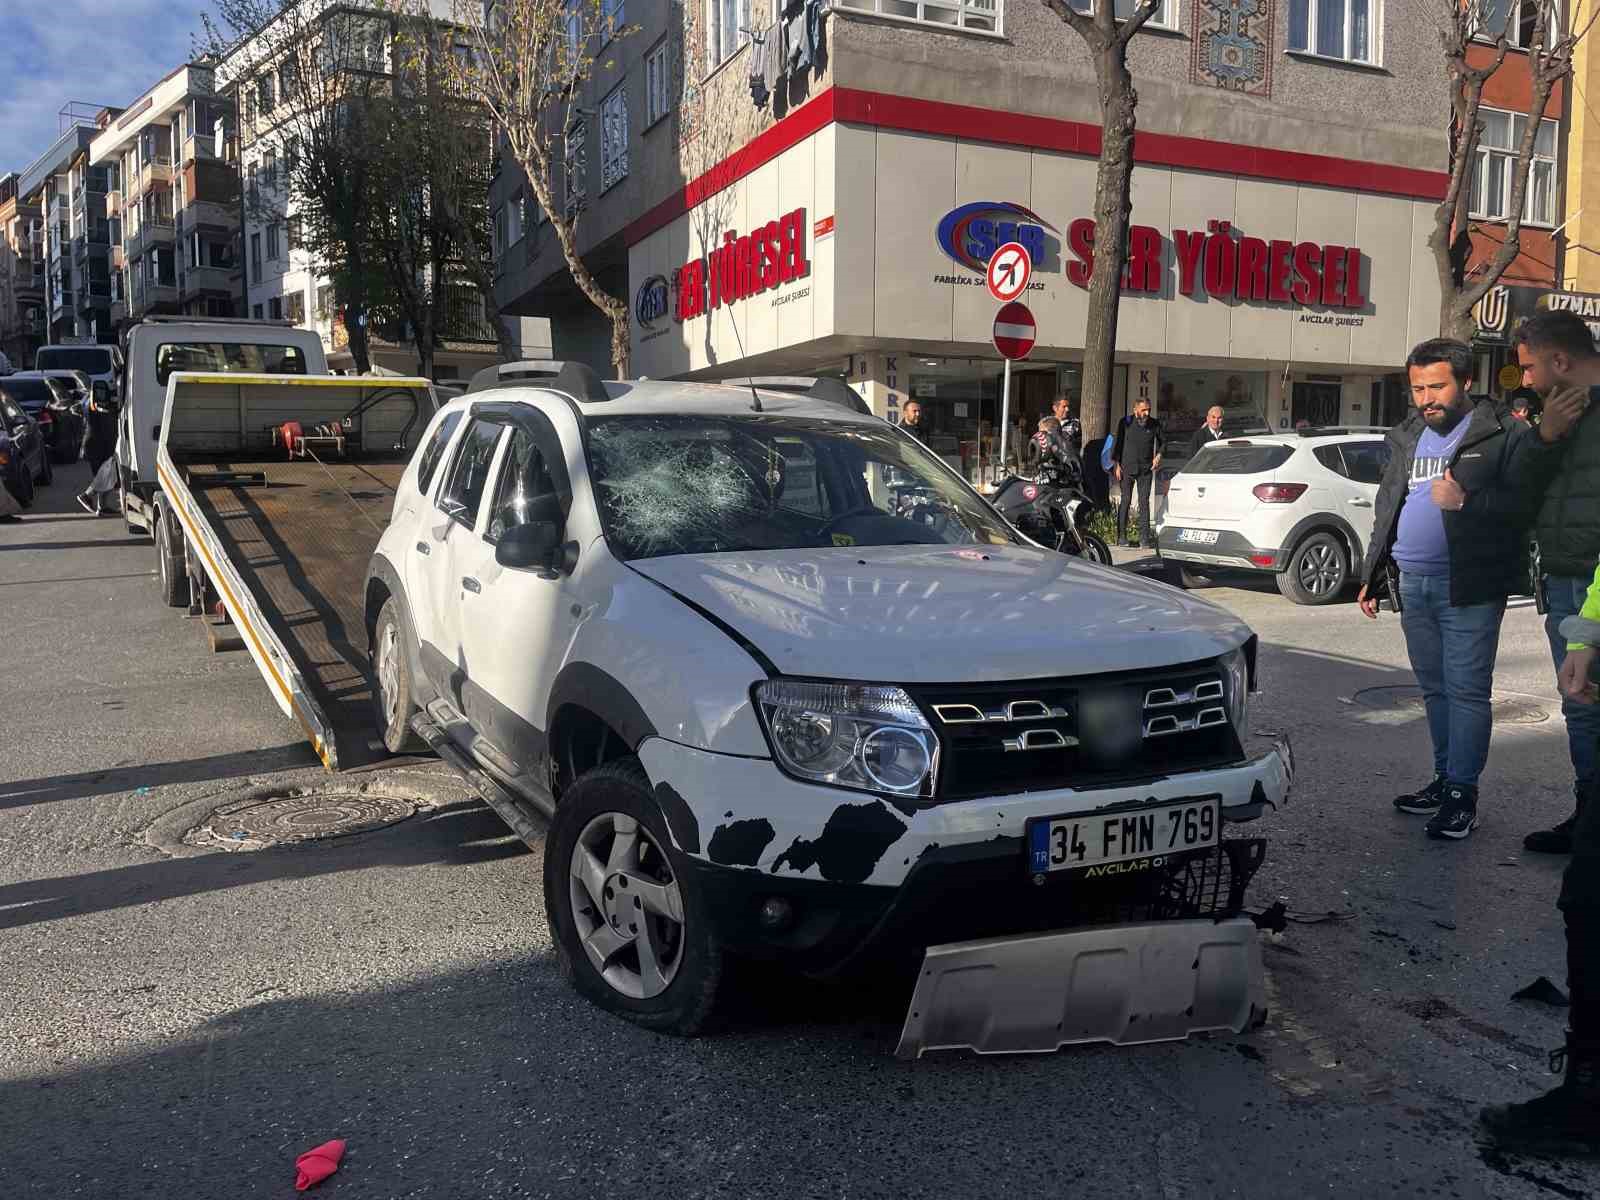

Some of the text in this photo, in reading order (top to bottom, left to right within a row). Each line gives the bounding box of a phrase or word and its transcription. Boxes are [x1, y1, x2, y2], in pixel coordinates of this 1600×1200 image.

[708, 207, 808, 309] YÖRESEL
[1066, 218, 1366, 307] SR YÖRESEL
[934, 275, 972, 286] FABRİKA
[1299, 315, 1363, 327] AVCILAR ŞUBESİ
[1051, 805, 1214, 865] 34 FMN 769
[1034, 850, 1048, 865] TR
[1084, 860, 1149, 878] AVCILAR
